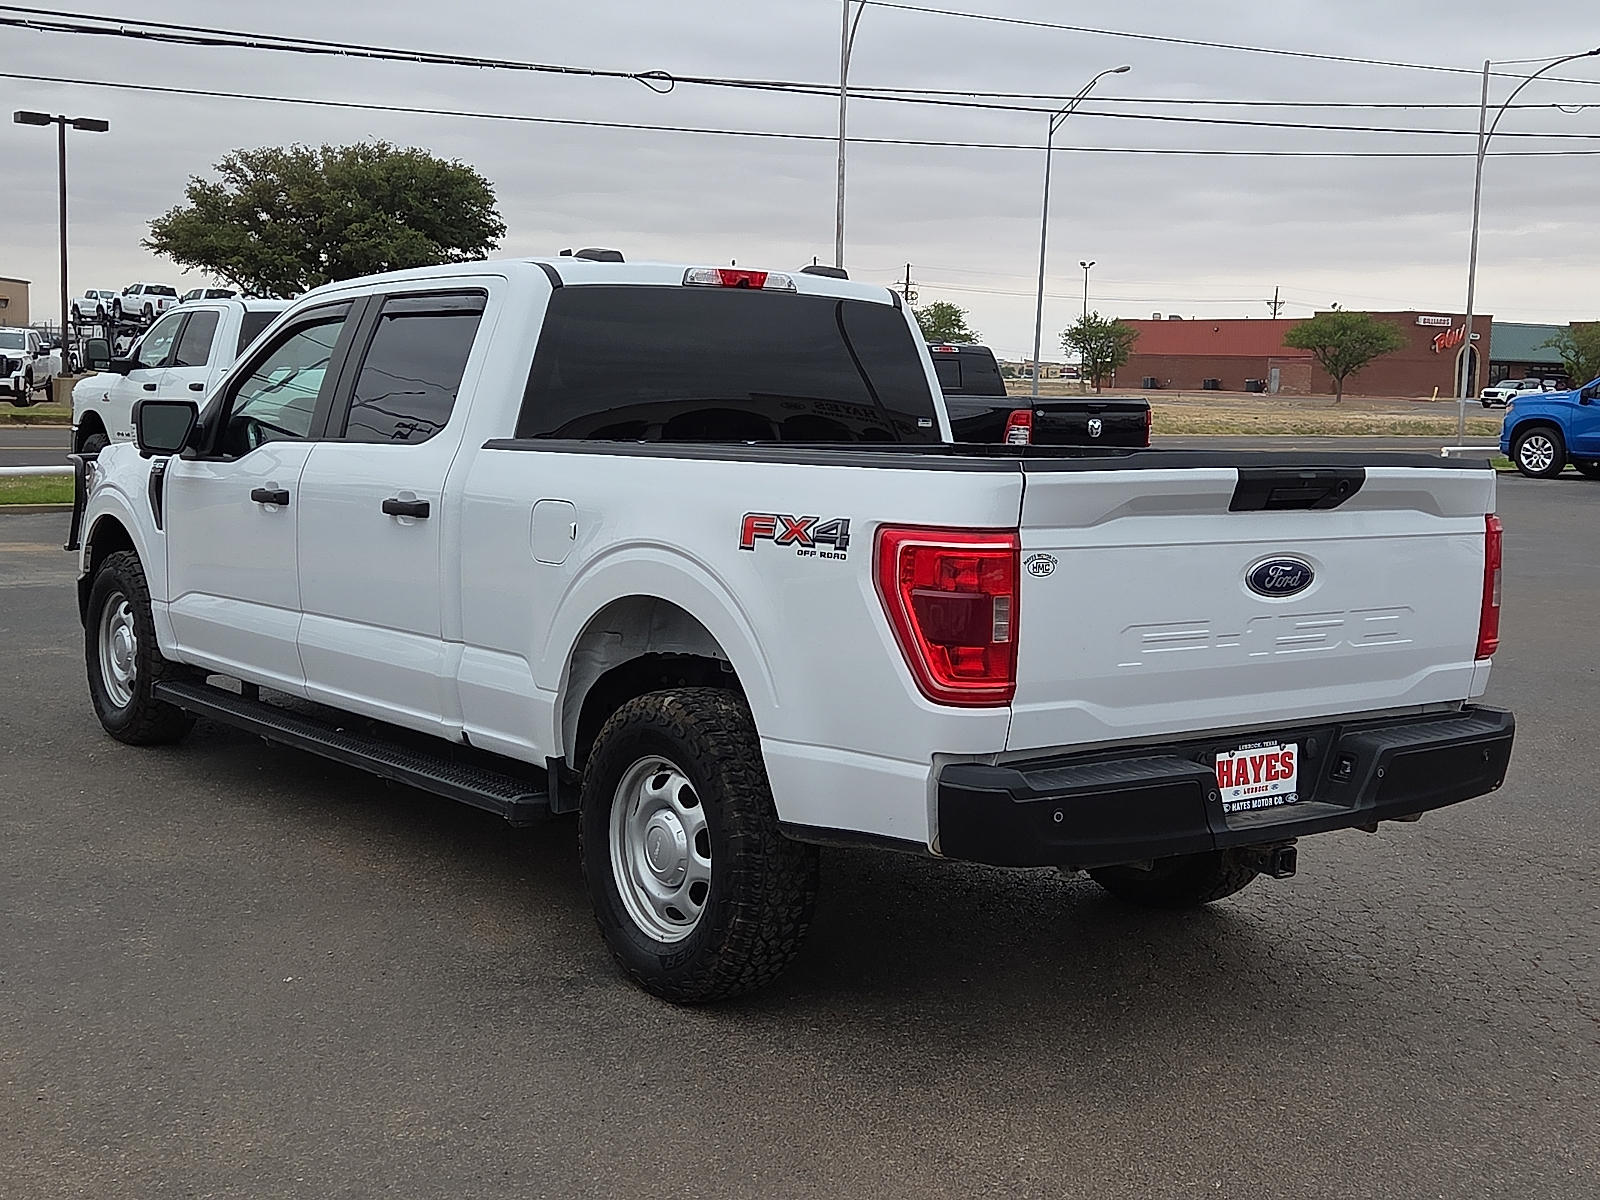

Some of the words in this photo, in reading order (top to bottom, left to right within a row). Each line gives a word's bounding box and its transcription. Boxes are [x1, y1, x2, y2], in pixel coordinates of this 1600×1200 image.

[738, 512, 850, 551] FX4
[797, 549, 817, 557] OFF
[820, 551, 847, 560] ROAD
[1032, 562, 1050, 573] HMC
[1265, 565, 1301, 588] Ford
[1117, 606, 1415, 666] F-150
[1217, 751, 1294, 788] HAYES
[1243, 785, 1269, 794] LUBBOCK
[1232, 801, 1250, 811] HAYES
[1252, 798, 1272, 808] MOTOR
